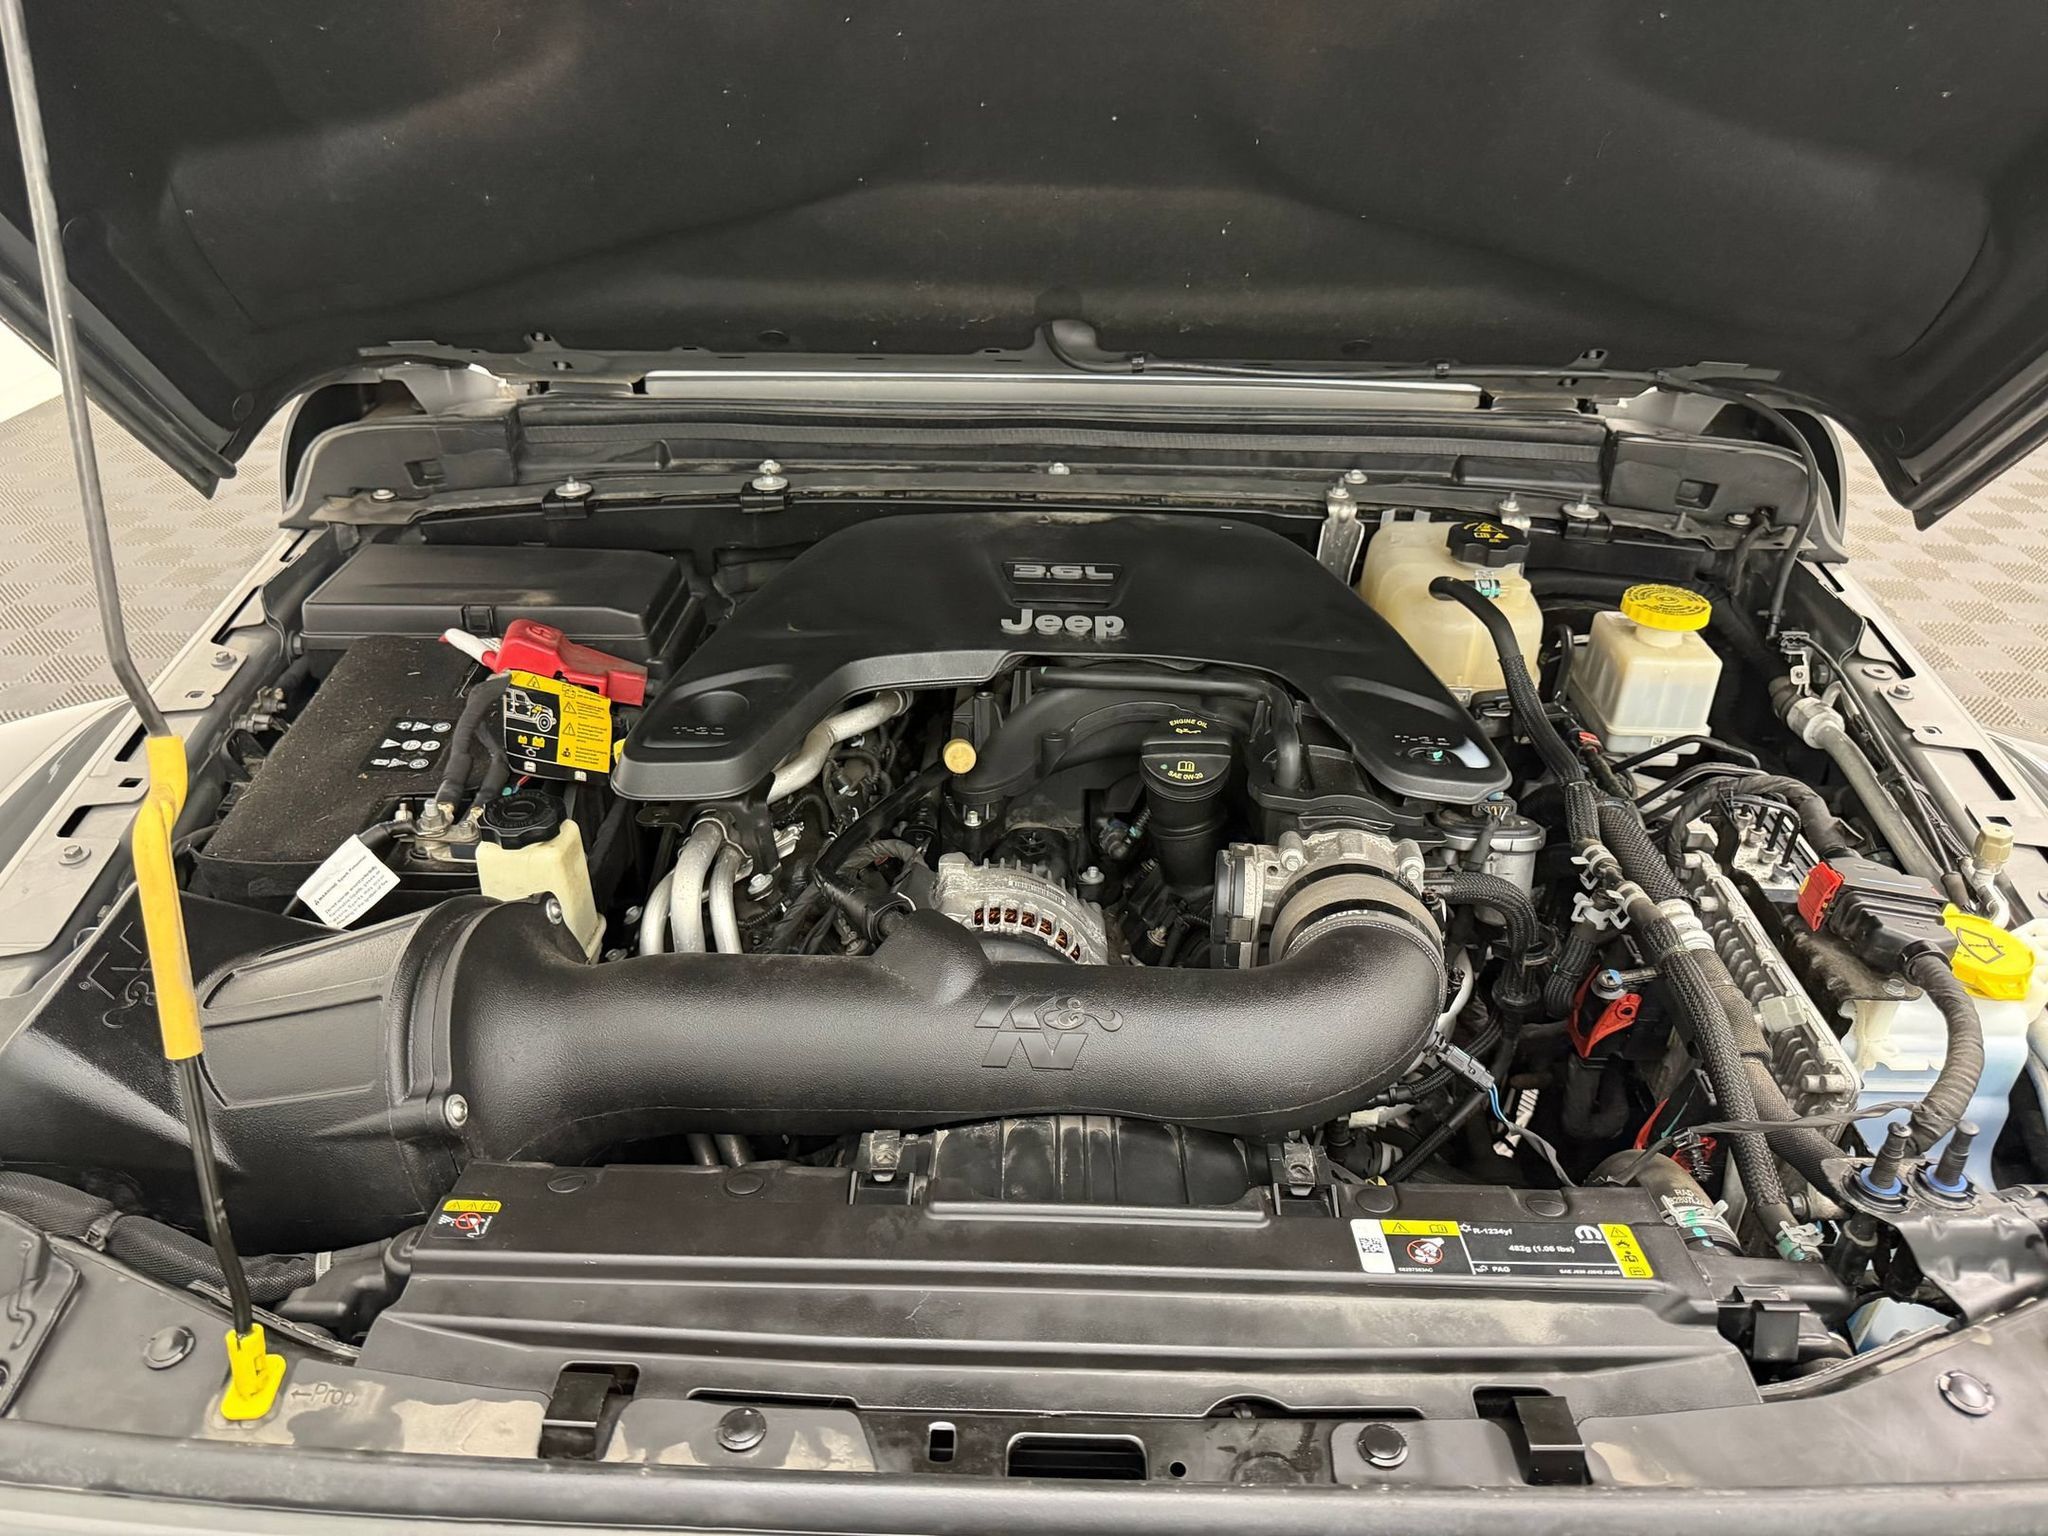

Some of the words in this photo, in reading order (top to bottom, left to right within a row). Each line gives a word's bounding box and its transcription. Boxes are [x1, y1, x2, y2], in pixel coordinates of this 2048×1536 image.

[1000, 608, 1125, 641] Jeep
[1168, 718, 1196, 727] ENGINE
[1196, 720, 1208, 729] OIL
[1167, 770, 1182, 779] SAE
[309, 1382, 356, 1409] Prop
